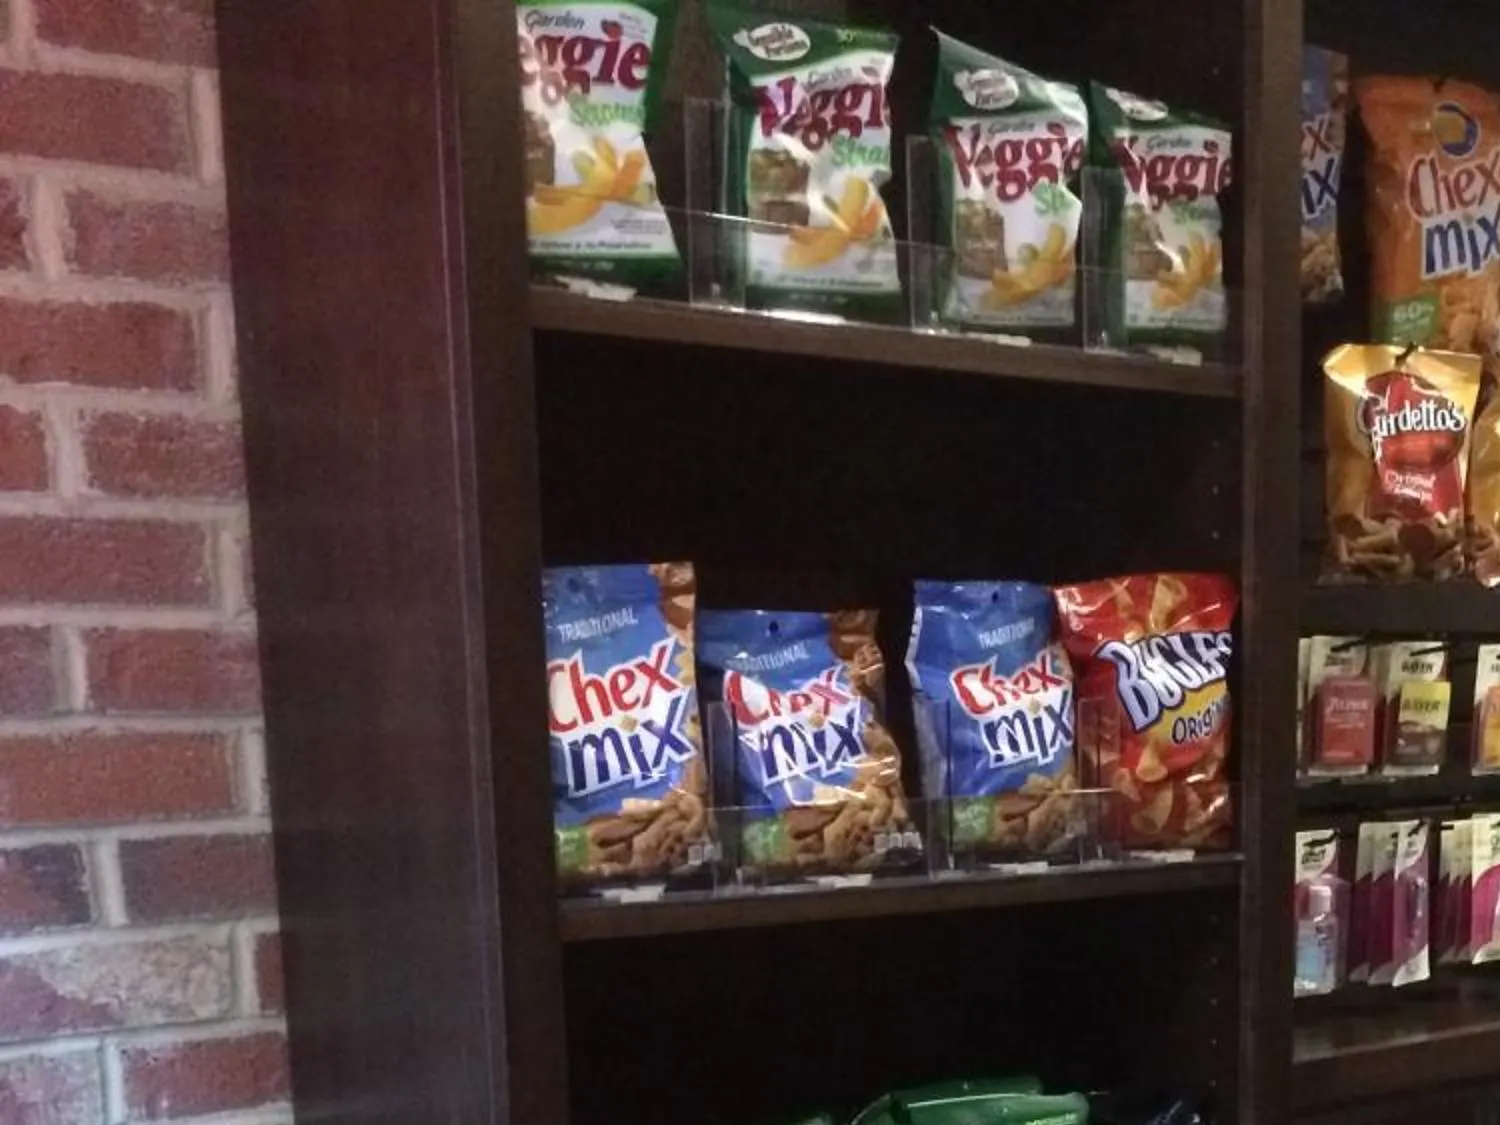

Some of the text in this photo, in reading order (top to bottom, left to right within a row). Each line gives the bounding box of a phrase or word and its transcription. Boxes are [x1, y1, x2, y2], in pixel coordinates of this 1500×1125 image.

[557, 606, 639, 643] TRADITIONAL
[548, 644, 683, 735] Chex
[951, 652, 1067, 718] Chex
